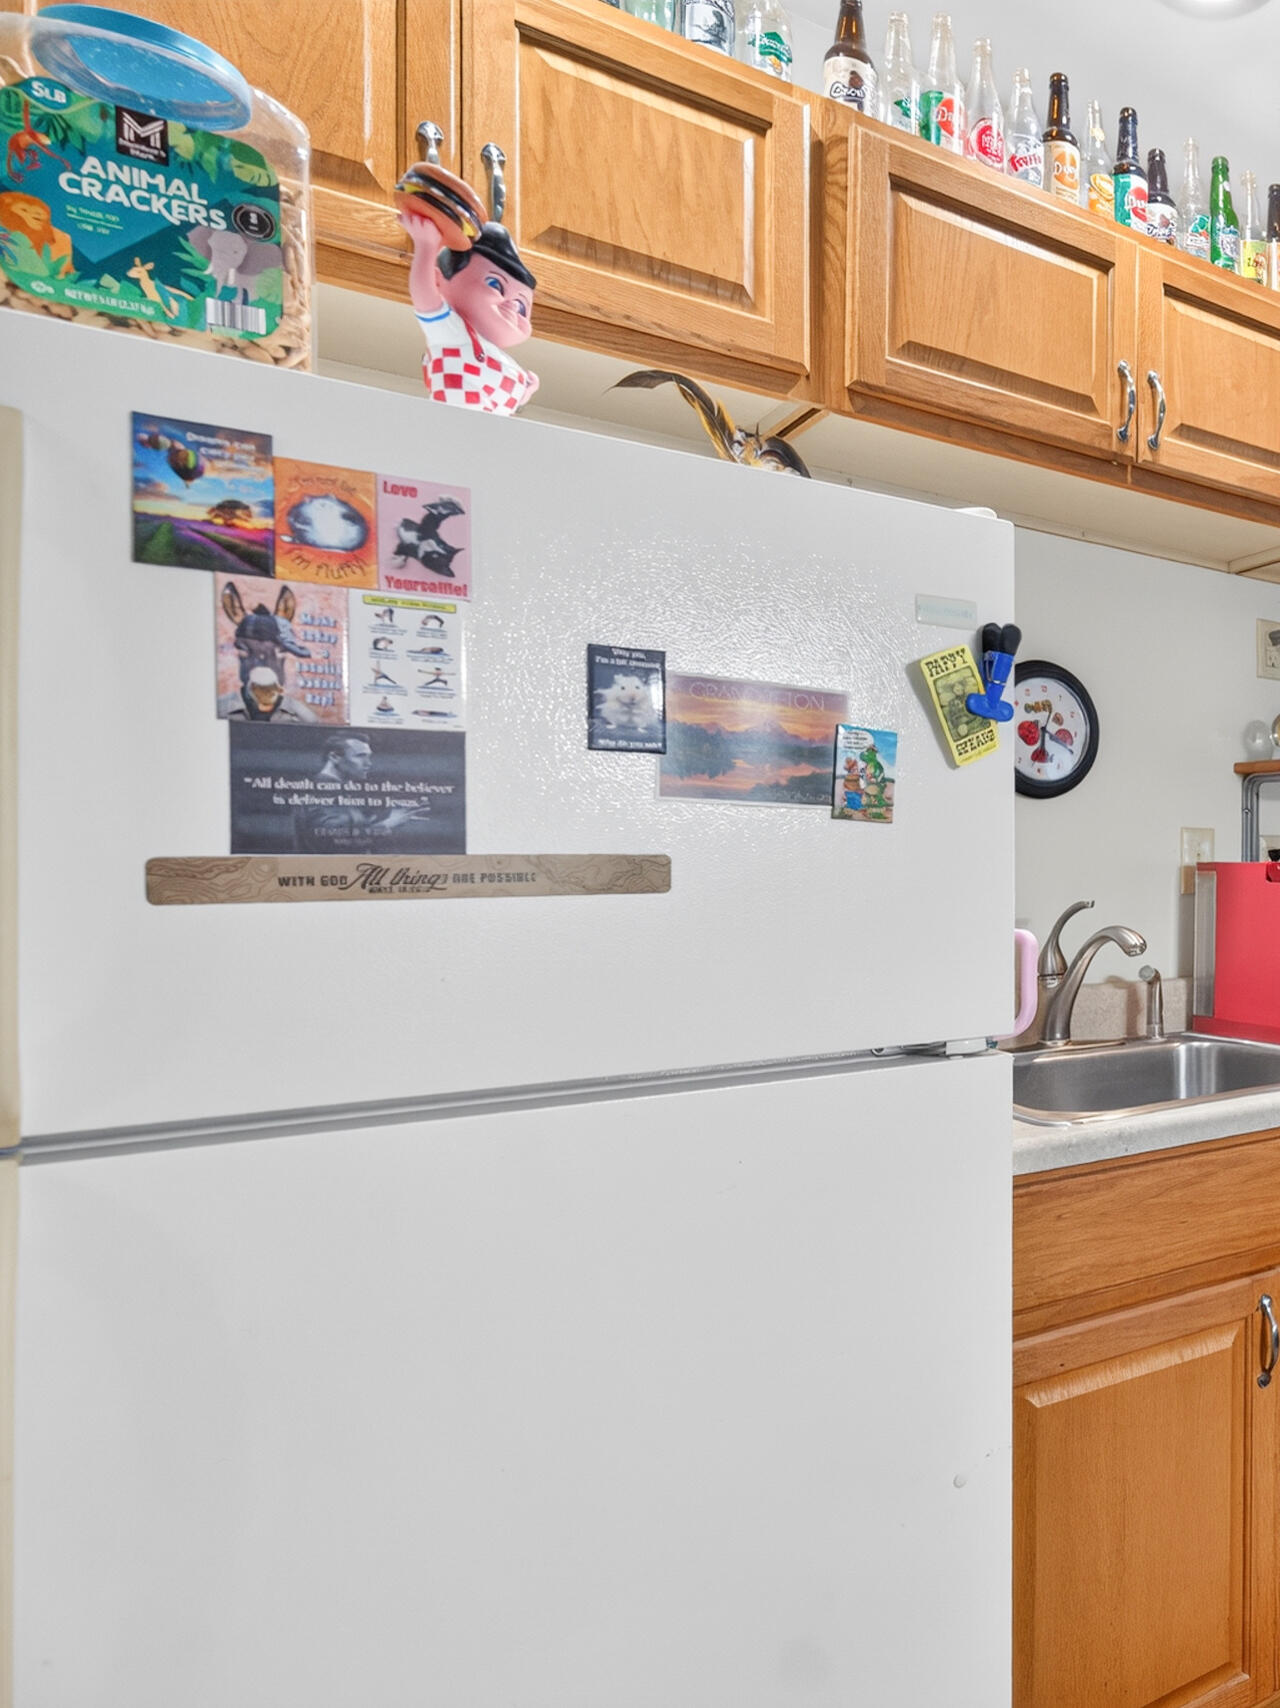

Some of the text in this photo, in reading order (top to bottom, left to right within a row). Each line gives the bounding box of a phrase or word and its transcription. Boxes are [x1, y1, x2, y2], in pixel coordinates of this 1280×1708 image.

[80, 155, 208, 206] ANIMAL
[58, 171, 228, 231] CRACKERS
[383, 480, 418, 498] Love
[274, 778, 314, 791] death
[316, 781, 341, 791] can
[344, 780, 362, 792] do
[364, 783, 379, 792] to
[381, 781, 403, 793] the
[404, 783, 456, 795] believer
[287, 794, 335, 806] deliver
[338, 796, 366, 807] him
[368, 797, 383, 807] to
[278, 876, 315, 887] WITH
[320, 875, 348, 887] GOD
[452, 873, 476, 884] ARE
[480, 872, 537, 884] POSSIBLE
